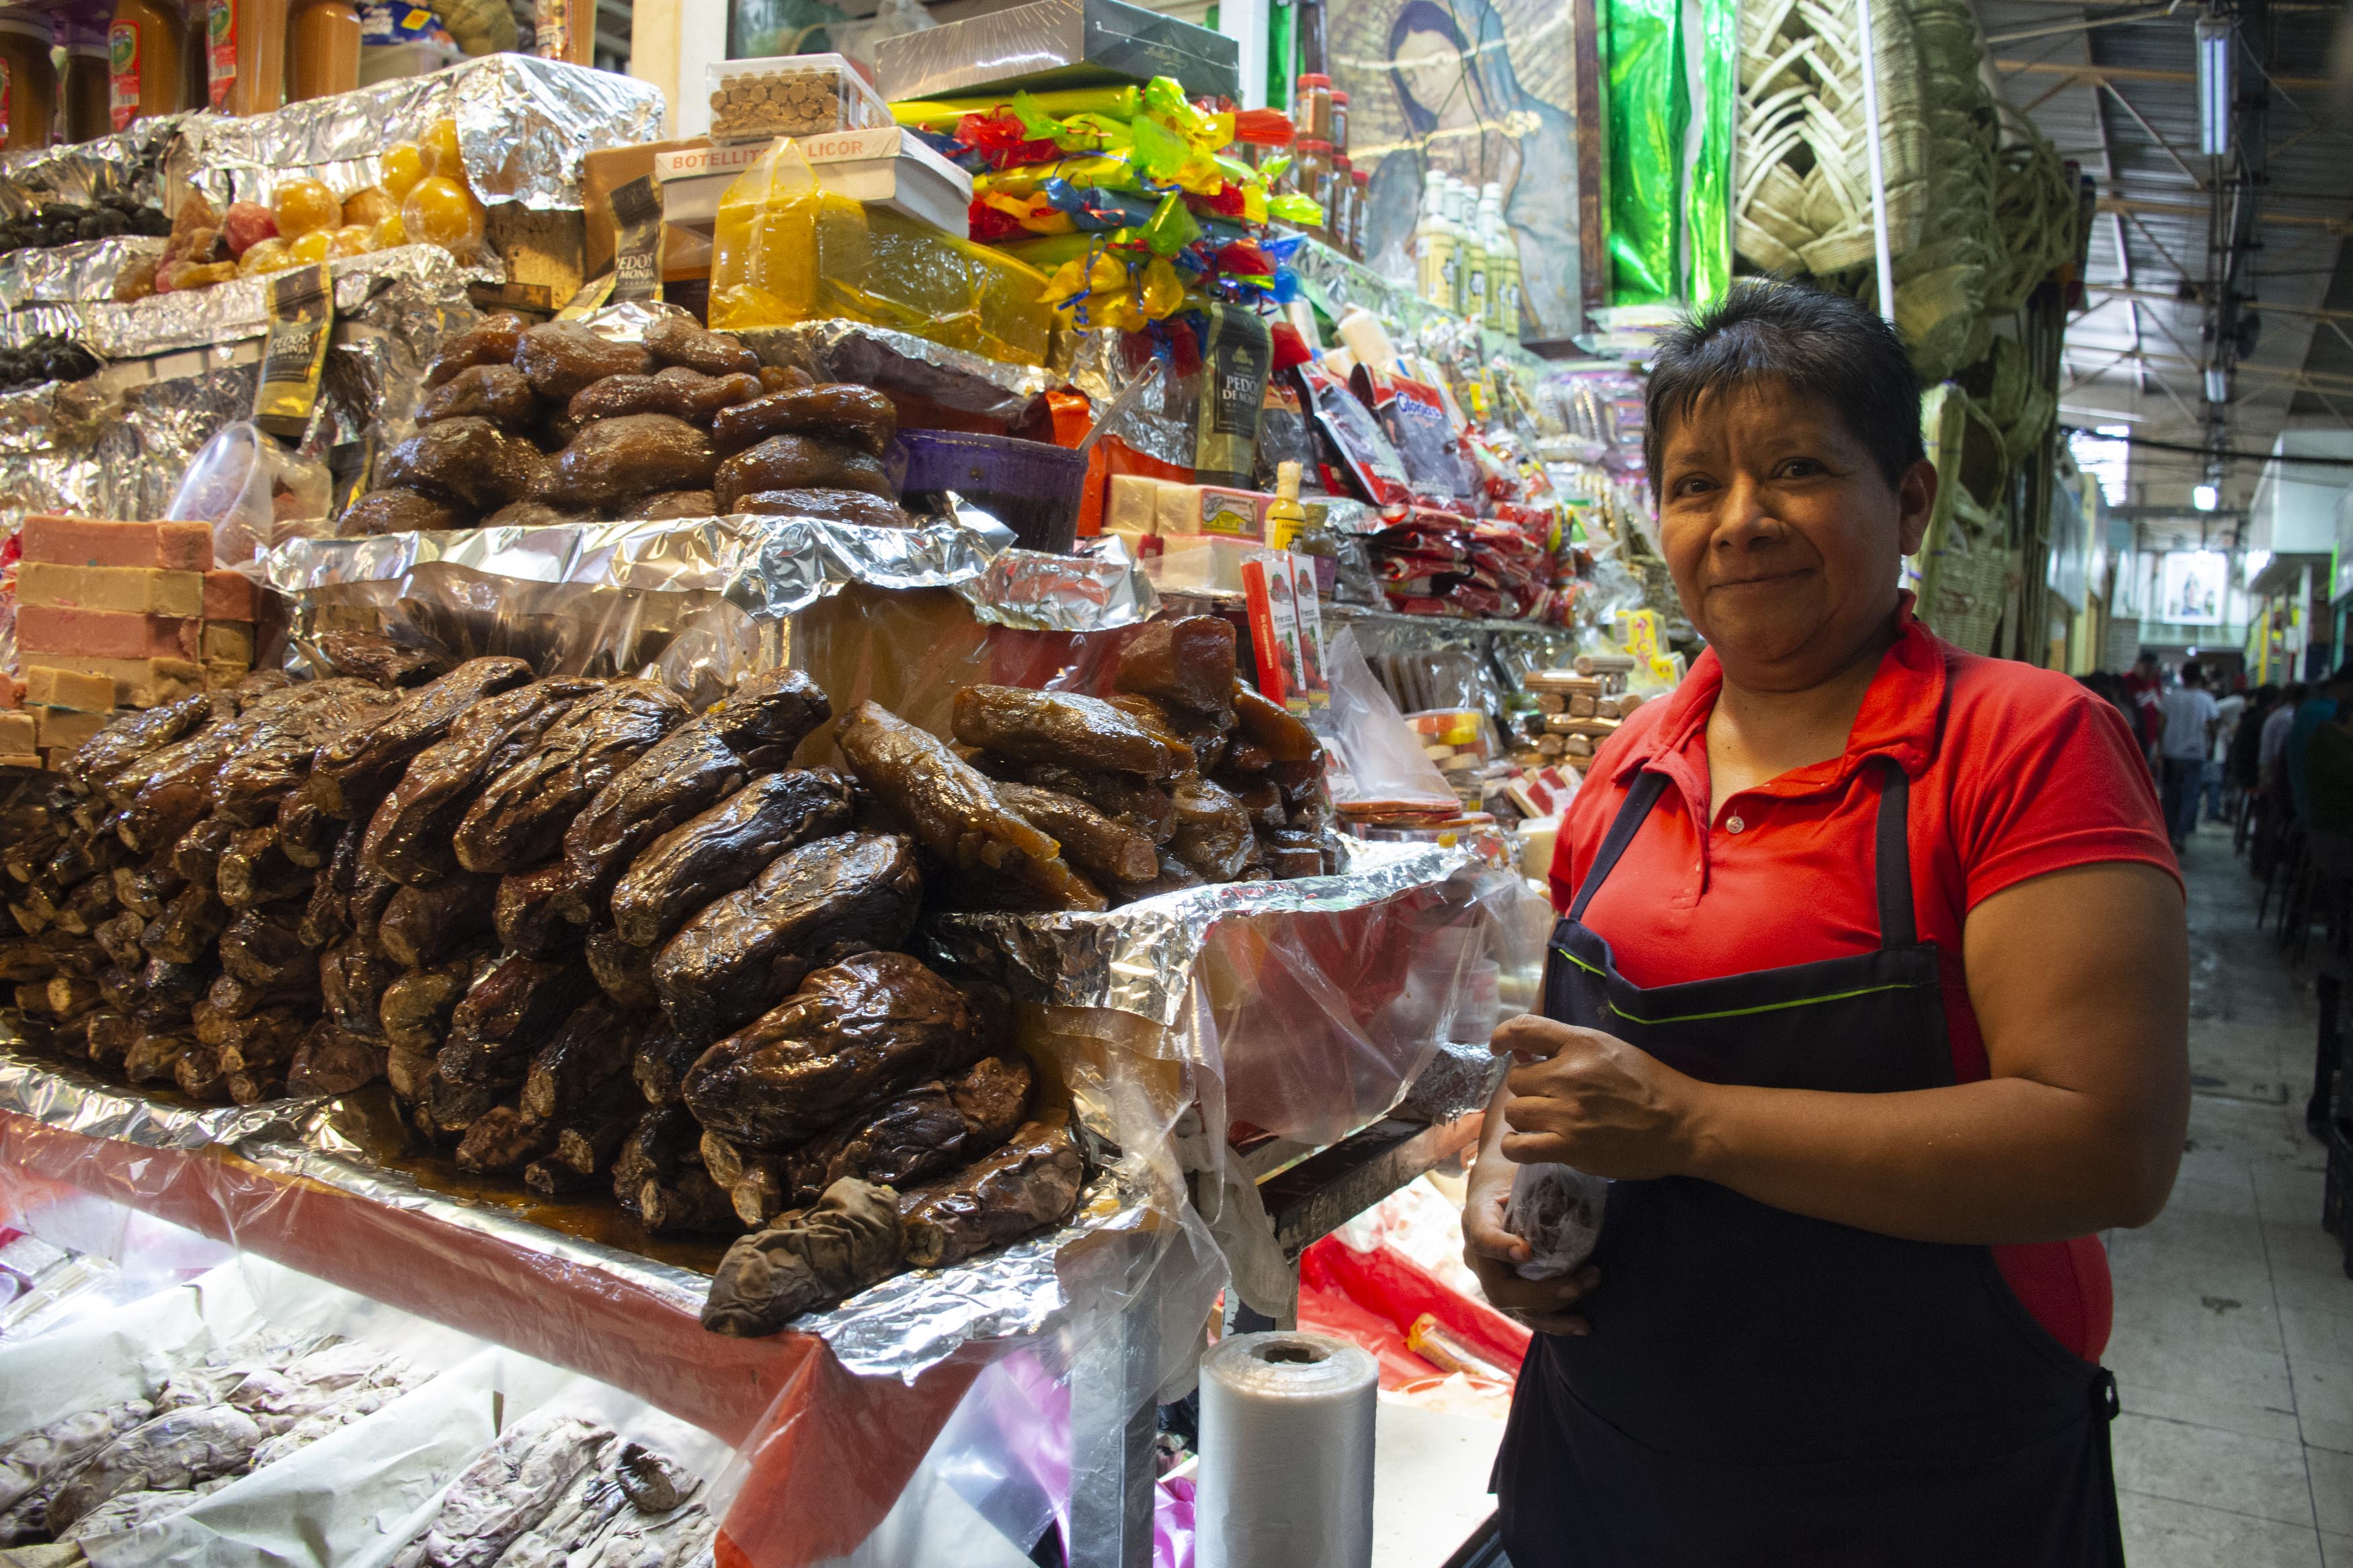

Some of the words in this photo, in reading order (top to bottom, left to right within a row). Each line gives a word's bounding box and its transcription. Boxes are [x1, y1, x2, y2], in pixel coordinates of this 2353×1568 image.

[808, 141, 863, 157] LICOR
[1222, 390, 1238, 401] DE
[1396, 391, 1441, 419] Glorias
